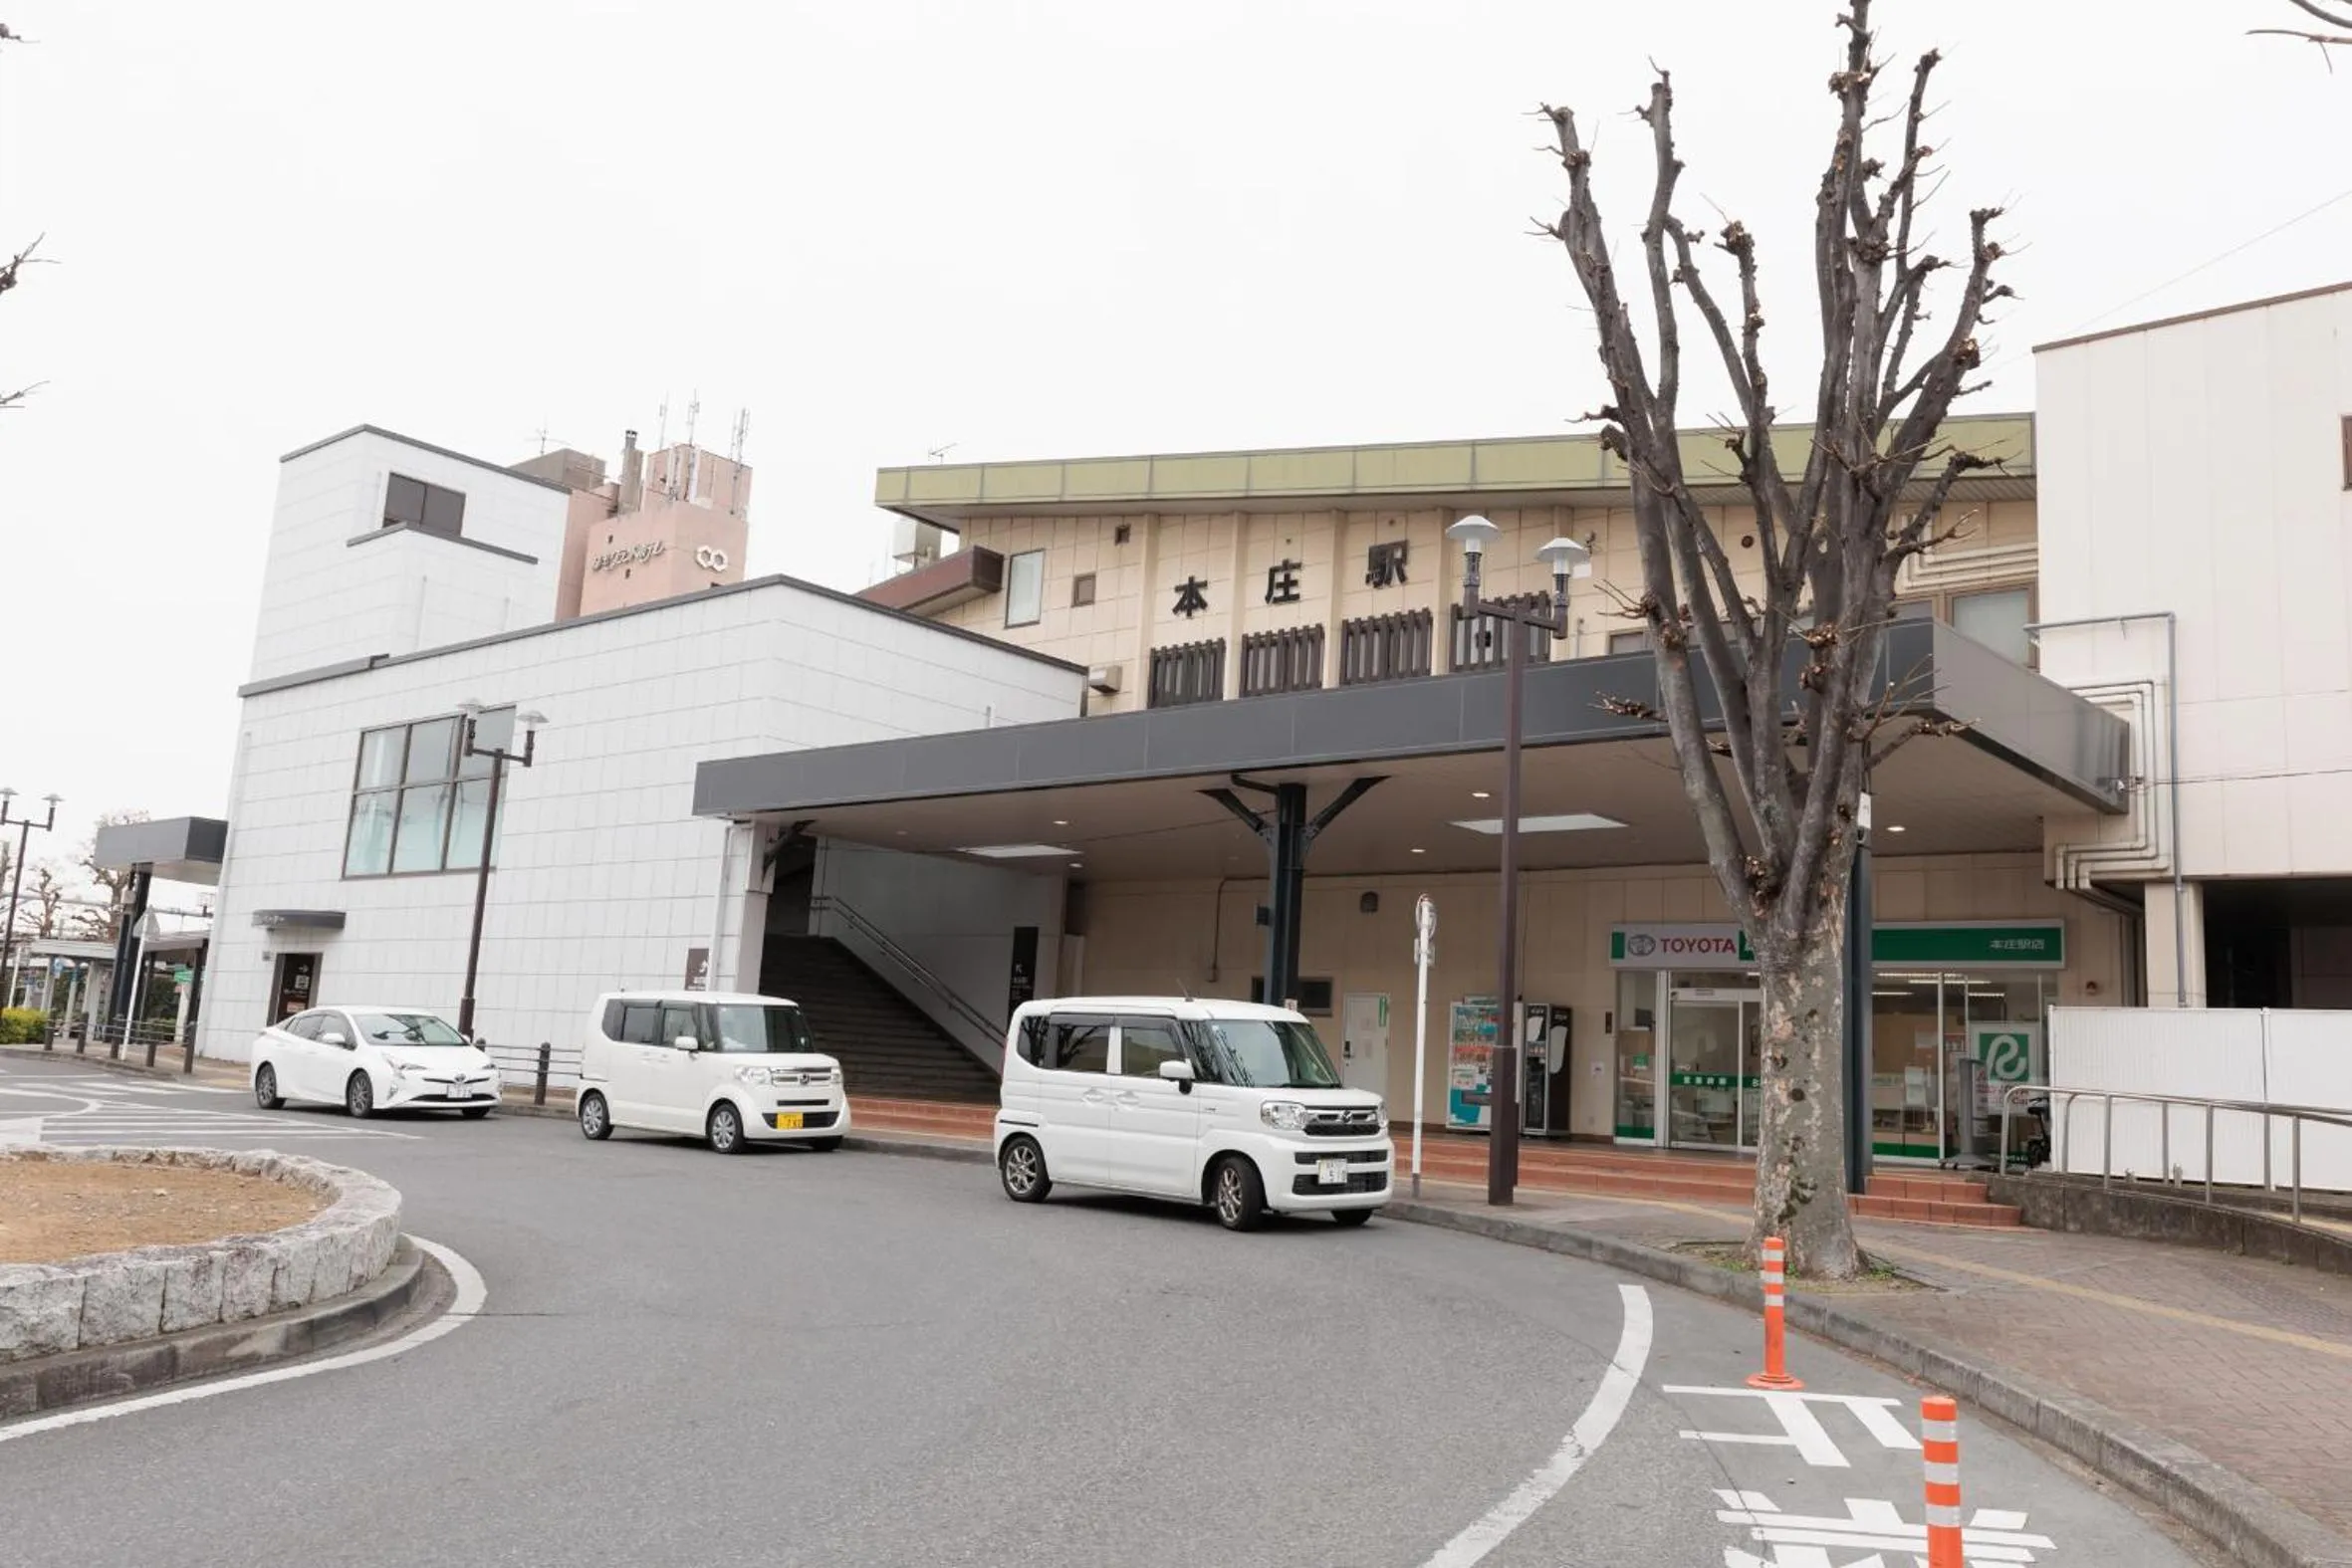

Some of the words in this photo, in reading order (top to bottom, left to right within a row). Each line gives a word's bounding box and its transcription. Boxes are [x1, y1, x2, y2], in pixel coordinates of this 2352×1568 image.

[1172, 539, 1409, 619] 本庄駅
[1660, 937, 1737, 954] TOYOTA
[1990, 938, 2045, 950] 本庄駅店
